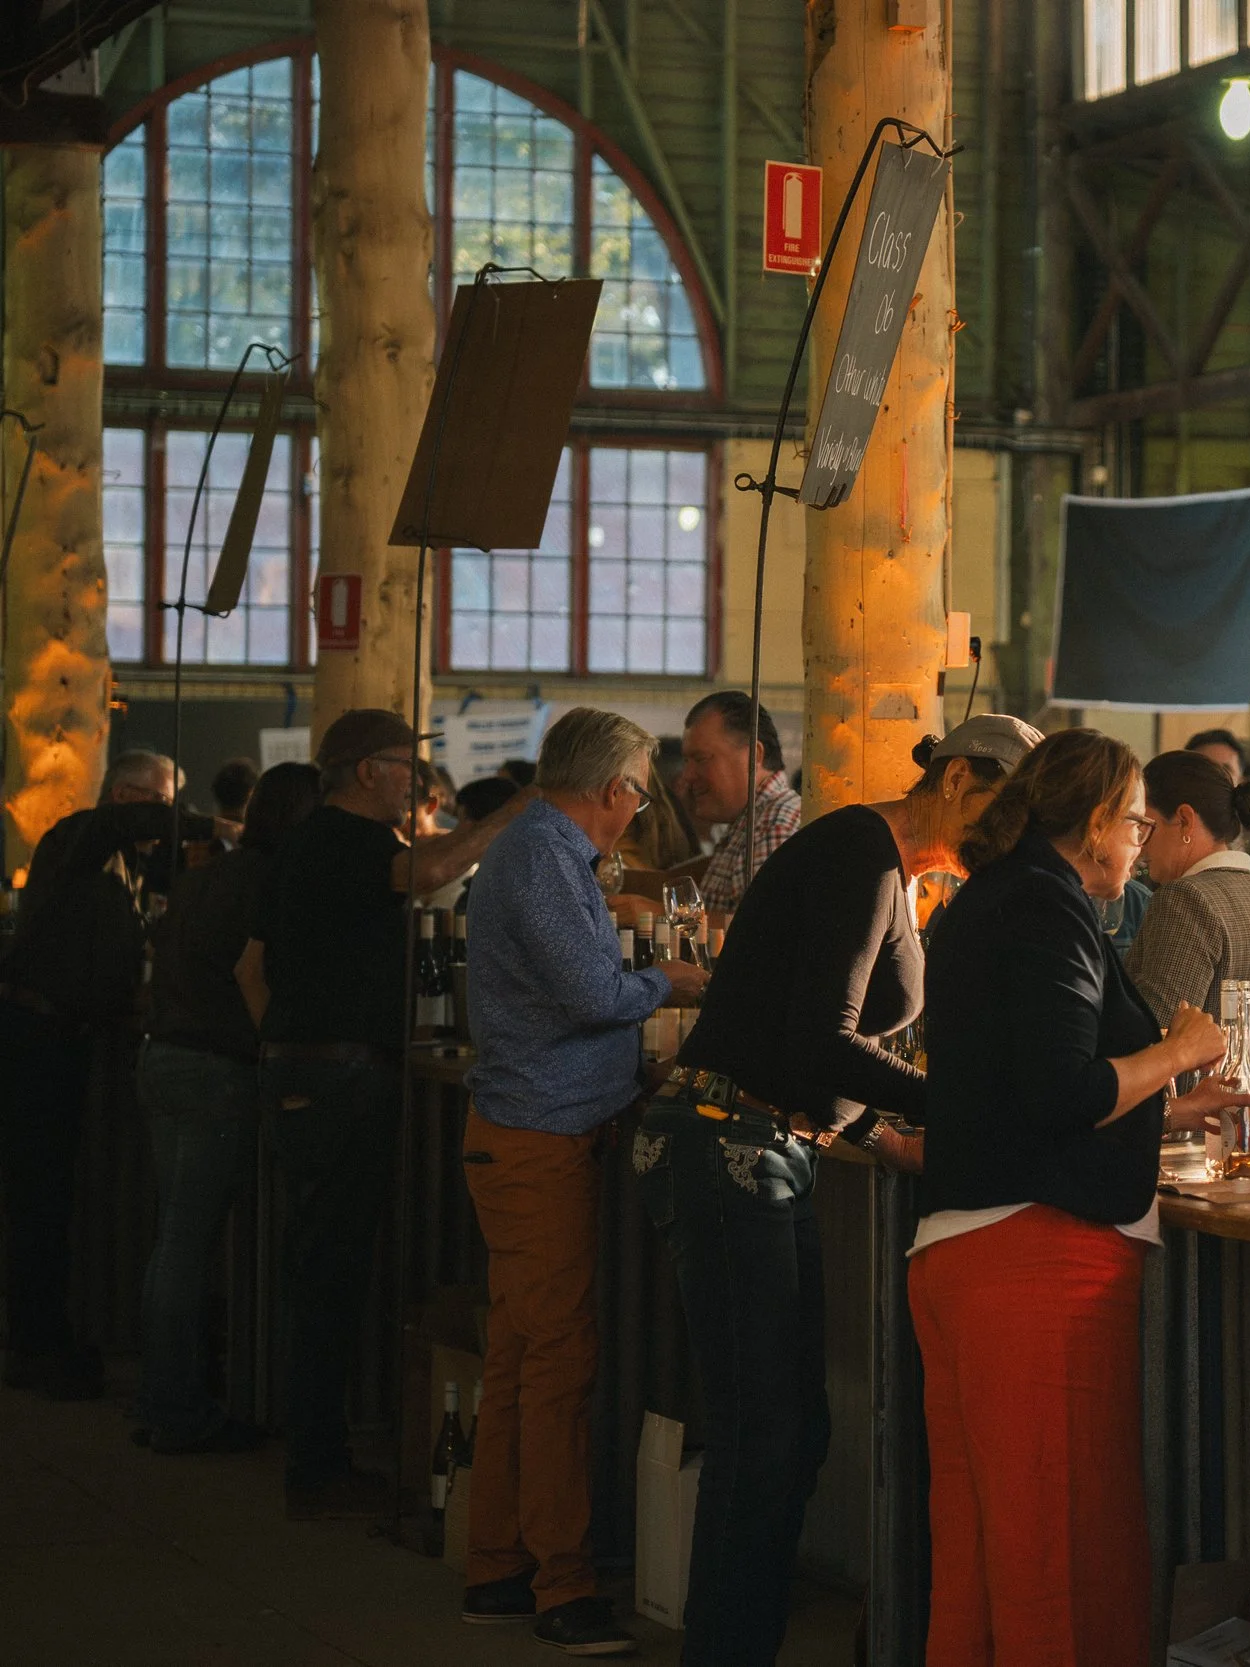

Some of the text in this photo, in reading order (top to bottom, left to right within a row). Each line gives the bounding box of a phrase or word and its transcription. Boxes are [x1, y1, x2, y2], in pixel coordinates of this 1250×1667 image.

[784, 243, 800, 252] FIRE
[868, 211, 911, 272] Class
[875, 289, 895, 334] 06
